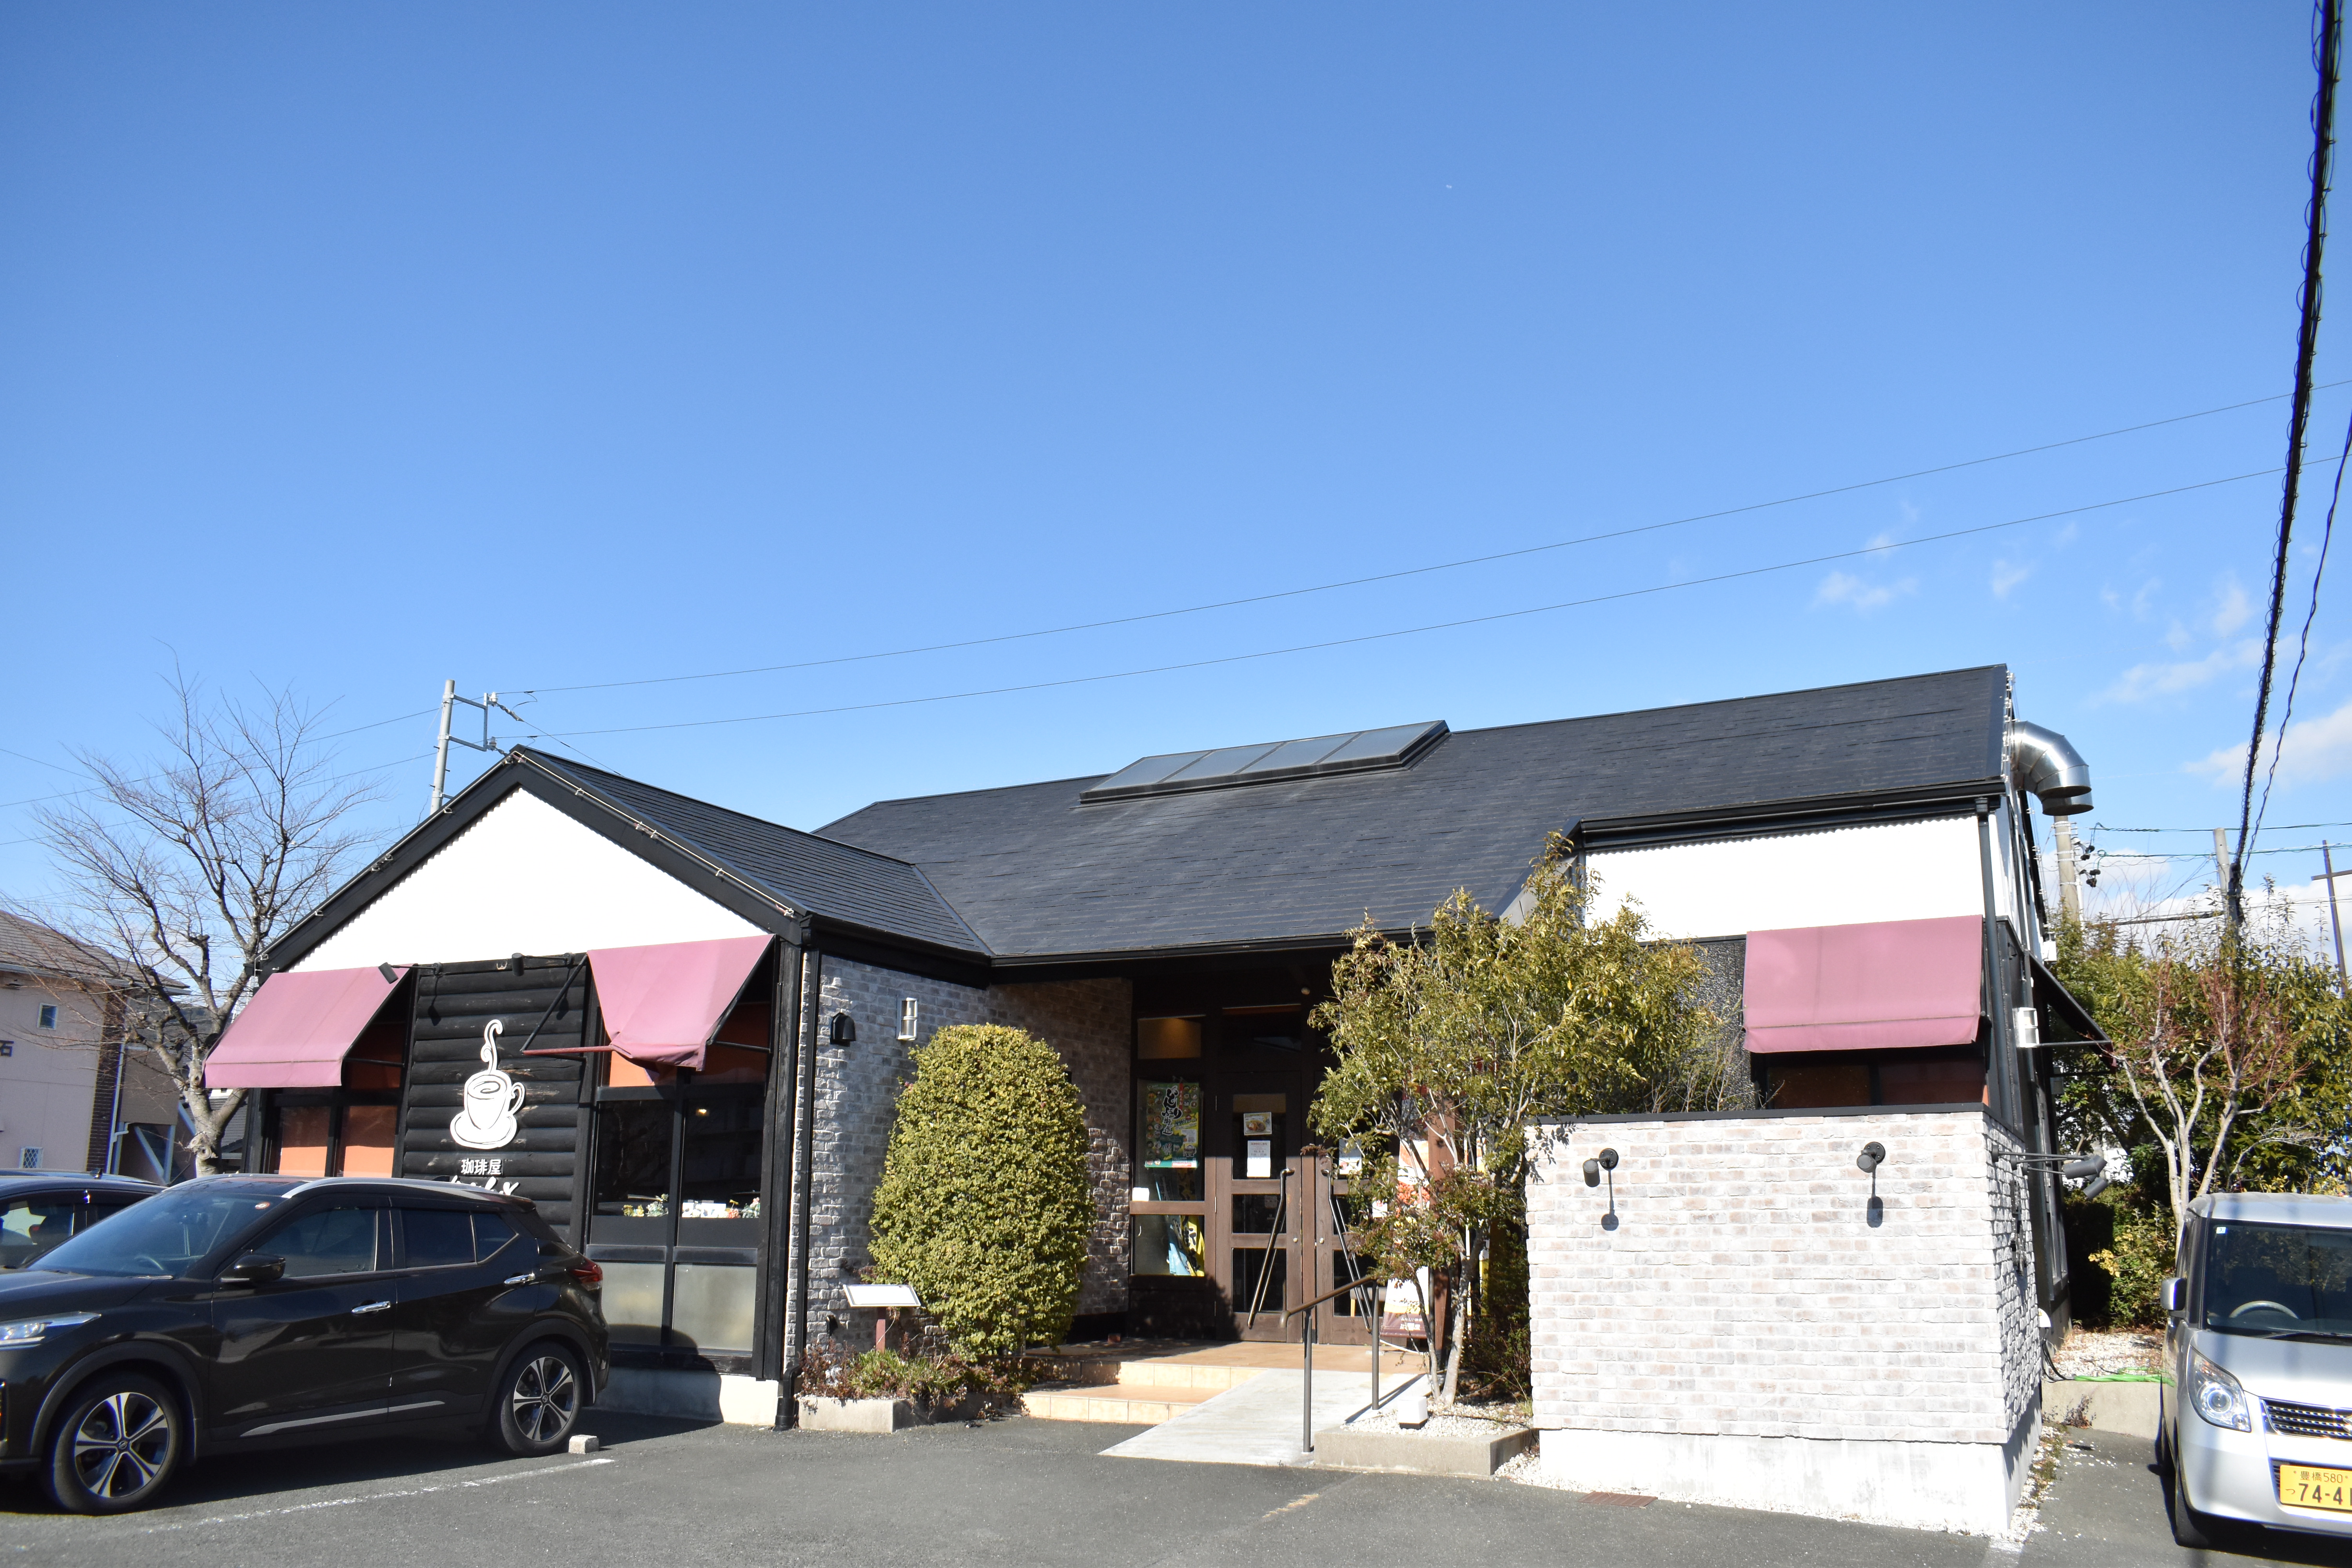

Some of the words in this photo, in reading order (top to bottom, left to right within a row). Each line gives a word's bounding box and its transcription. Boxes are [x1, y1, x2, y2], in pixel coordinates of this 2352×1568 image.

[461, 1158, 501, 1175] 珈琲屋
[2300, 1470, 2343, 1483] 豊橋580
